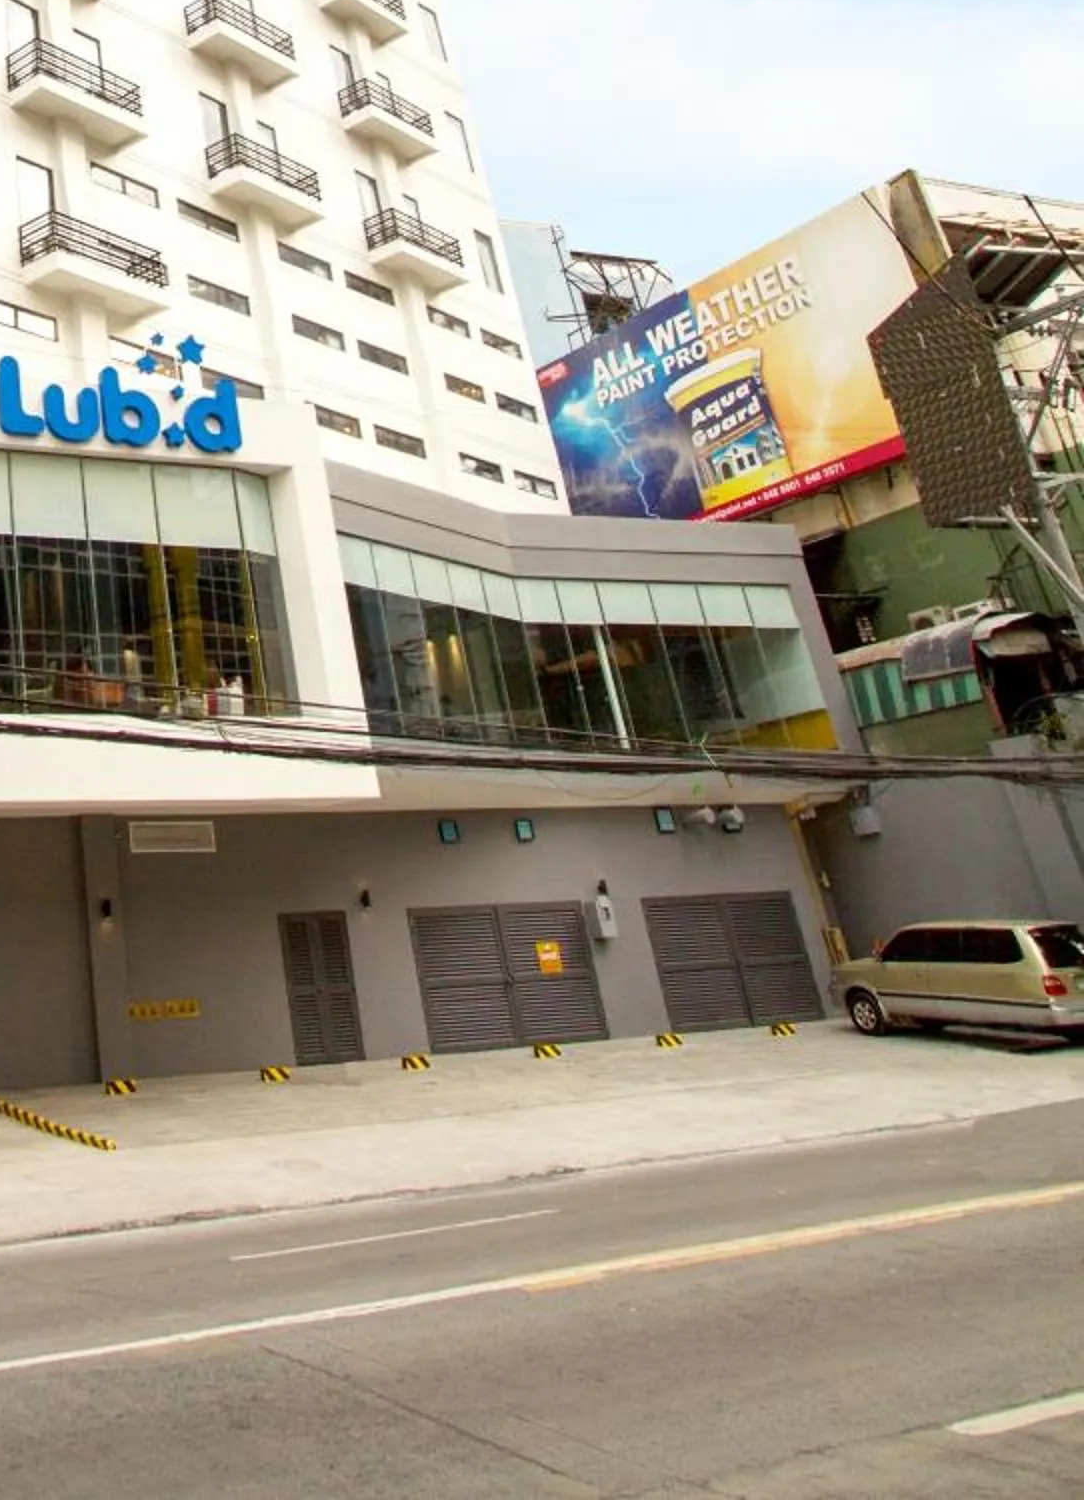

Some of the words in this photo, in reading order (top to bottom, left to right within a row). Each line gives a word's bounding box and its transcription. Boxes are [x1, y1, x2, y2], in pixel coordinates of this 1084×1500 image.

[592, 340, 645, 389] ALL
[645, 255, 804, 357] WEATHER
[595, 363, 656, 408] PAINT
[660, 288, 812, 376] PROTECTION
[691, 383, 750, 428] Aqua
[692, 395, 761, 447] Guard
